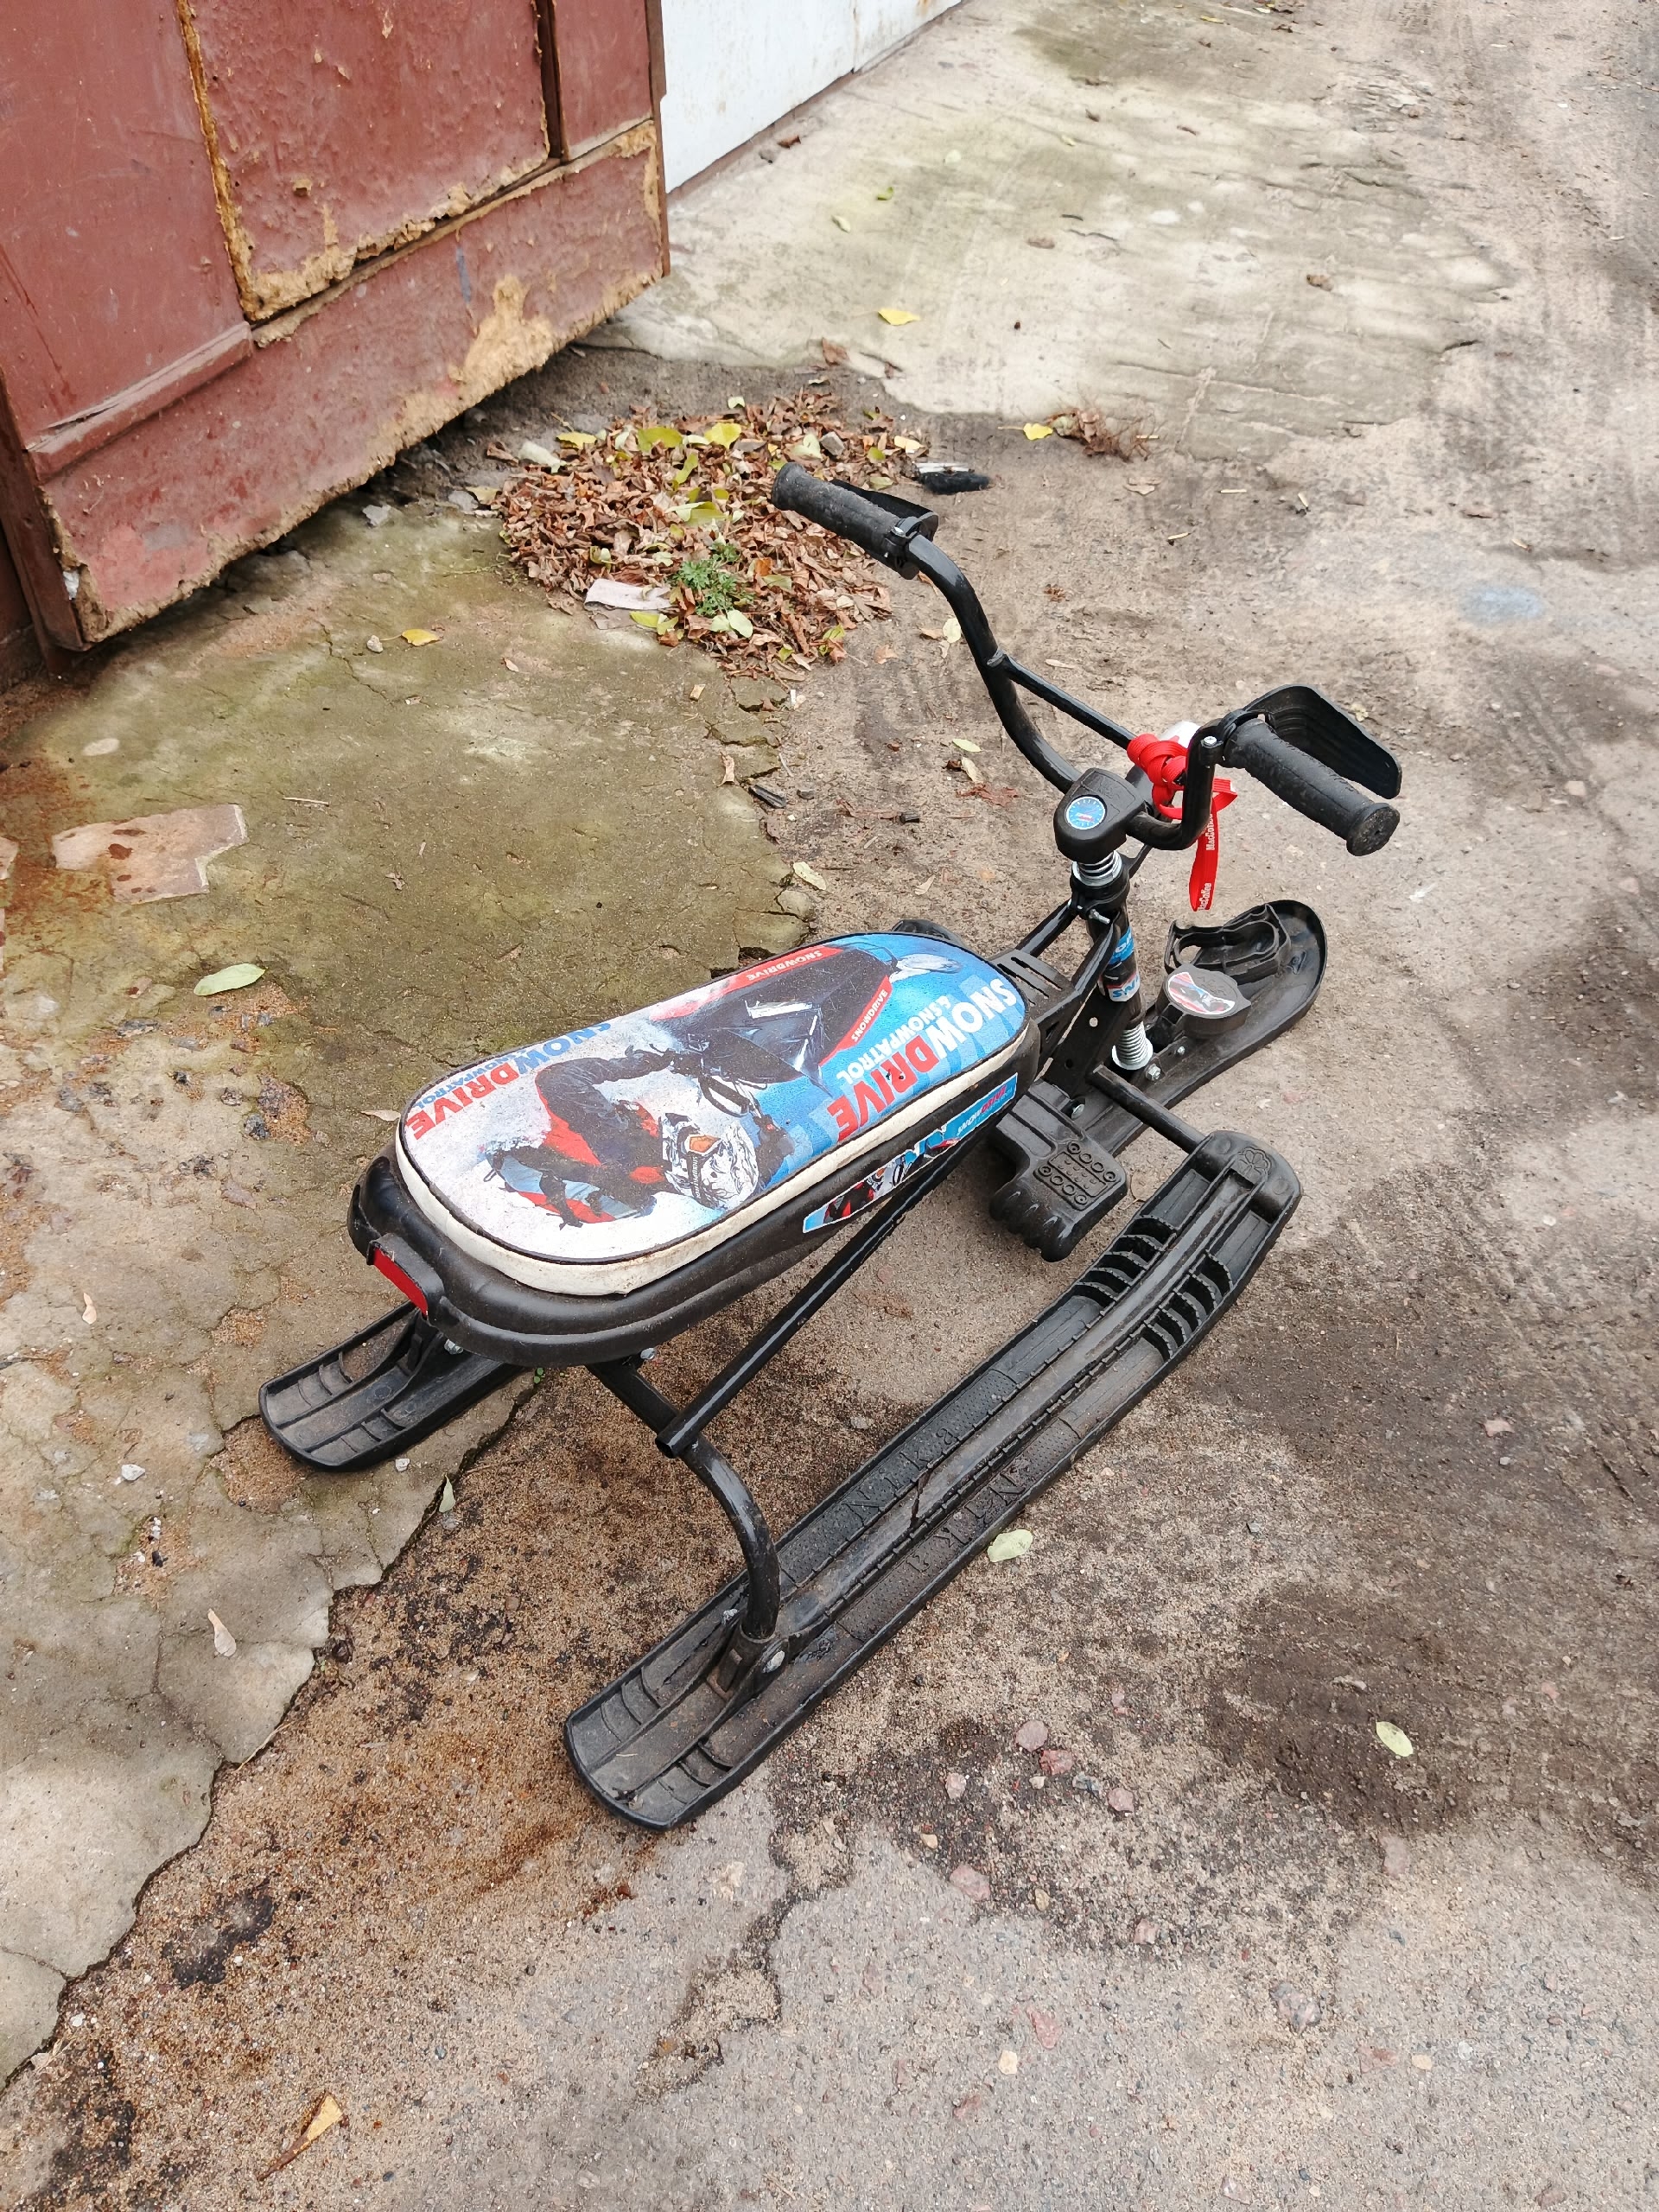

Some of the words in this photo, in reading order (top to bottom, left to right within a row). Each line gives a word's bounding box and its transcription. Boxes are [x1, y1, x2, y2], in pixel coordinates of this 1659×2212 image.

[746, 949, 824, 983] SNOWDRIVE
[851, 988, 888, 1042] SNOWDRIVE
[405, 1021, 612, 1141] SNOWDRIVE
[827, 978, 1018, 1142] SNOWDRIVE
[842, 1425, 963, 1524] Nika
